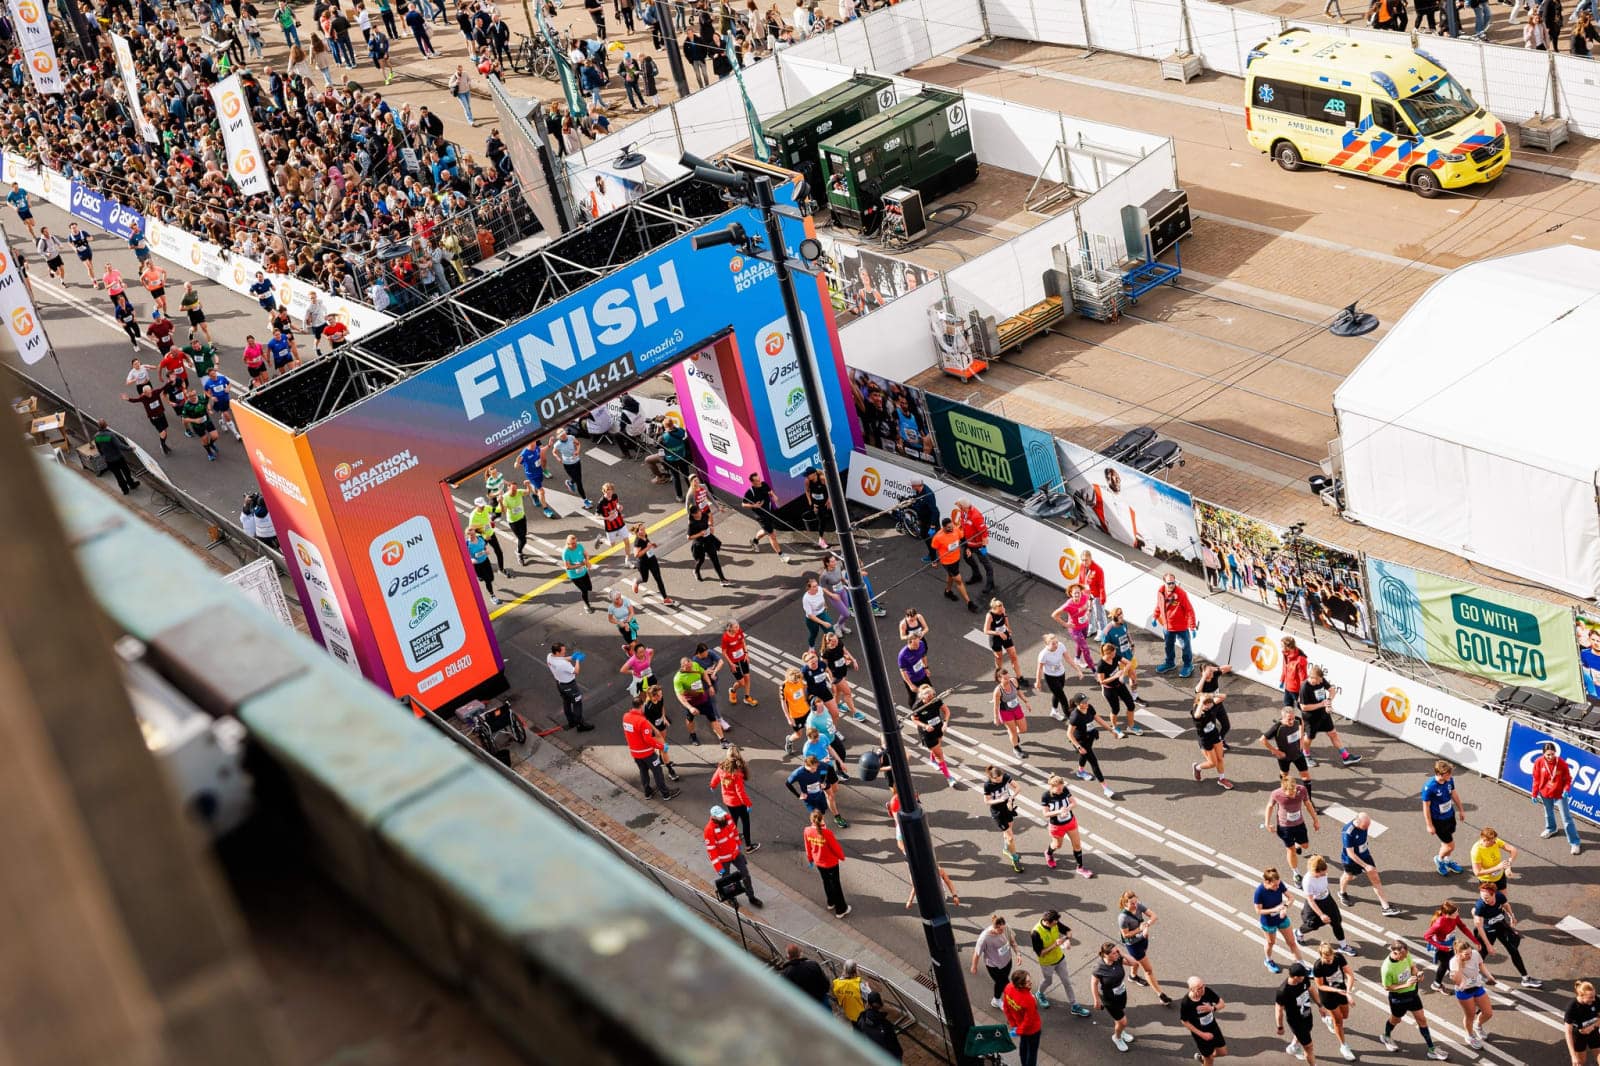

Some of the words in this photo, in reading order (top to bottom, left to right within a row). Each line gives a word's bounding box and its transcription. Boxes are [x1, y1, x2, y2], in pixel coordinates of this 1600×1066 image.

[1324, 98, 1345, 112] ARR
[1288, 121, 1334, 136] AMBULANCE
[82, 193, 101, 213] asics
[454, 259, 685, 421] FINISH
[640, 337, 676, 361] amazfit
[780, 360, 799, 377] asic
[540, 356, 634, 420] 01:44:41
[485, 419, 523, 445] amazfit
[955, 419, 968, 435] GO
[969, 424, 992, 443] WITH
[340, 449, 411, 493] MARATHON
[956, 441, 1014, 485] GOLAZO
[343, 455, 419, 503] ROTTERDAM
[884, 479, 913, 494] nationa
[406, 534, 423, 548] NN
[988, 530, 1020, 549] erlanden
[401, 564, 430, 588] asics
[1460, 602, 1479, 622] GO
[1481, 607, 1518, 634] WITH
[445, 654, 472, 677] GOLAZO
[1455, 628, 1547, 681] GOLAZO
[1416, 704, 1467, 731] nationale
[1414, 717, 1482, 751] nederlanden
[1571, 799, 1593, 816] mind,
